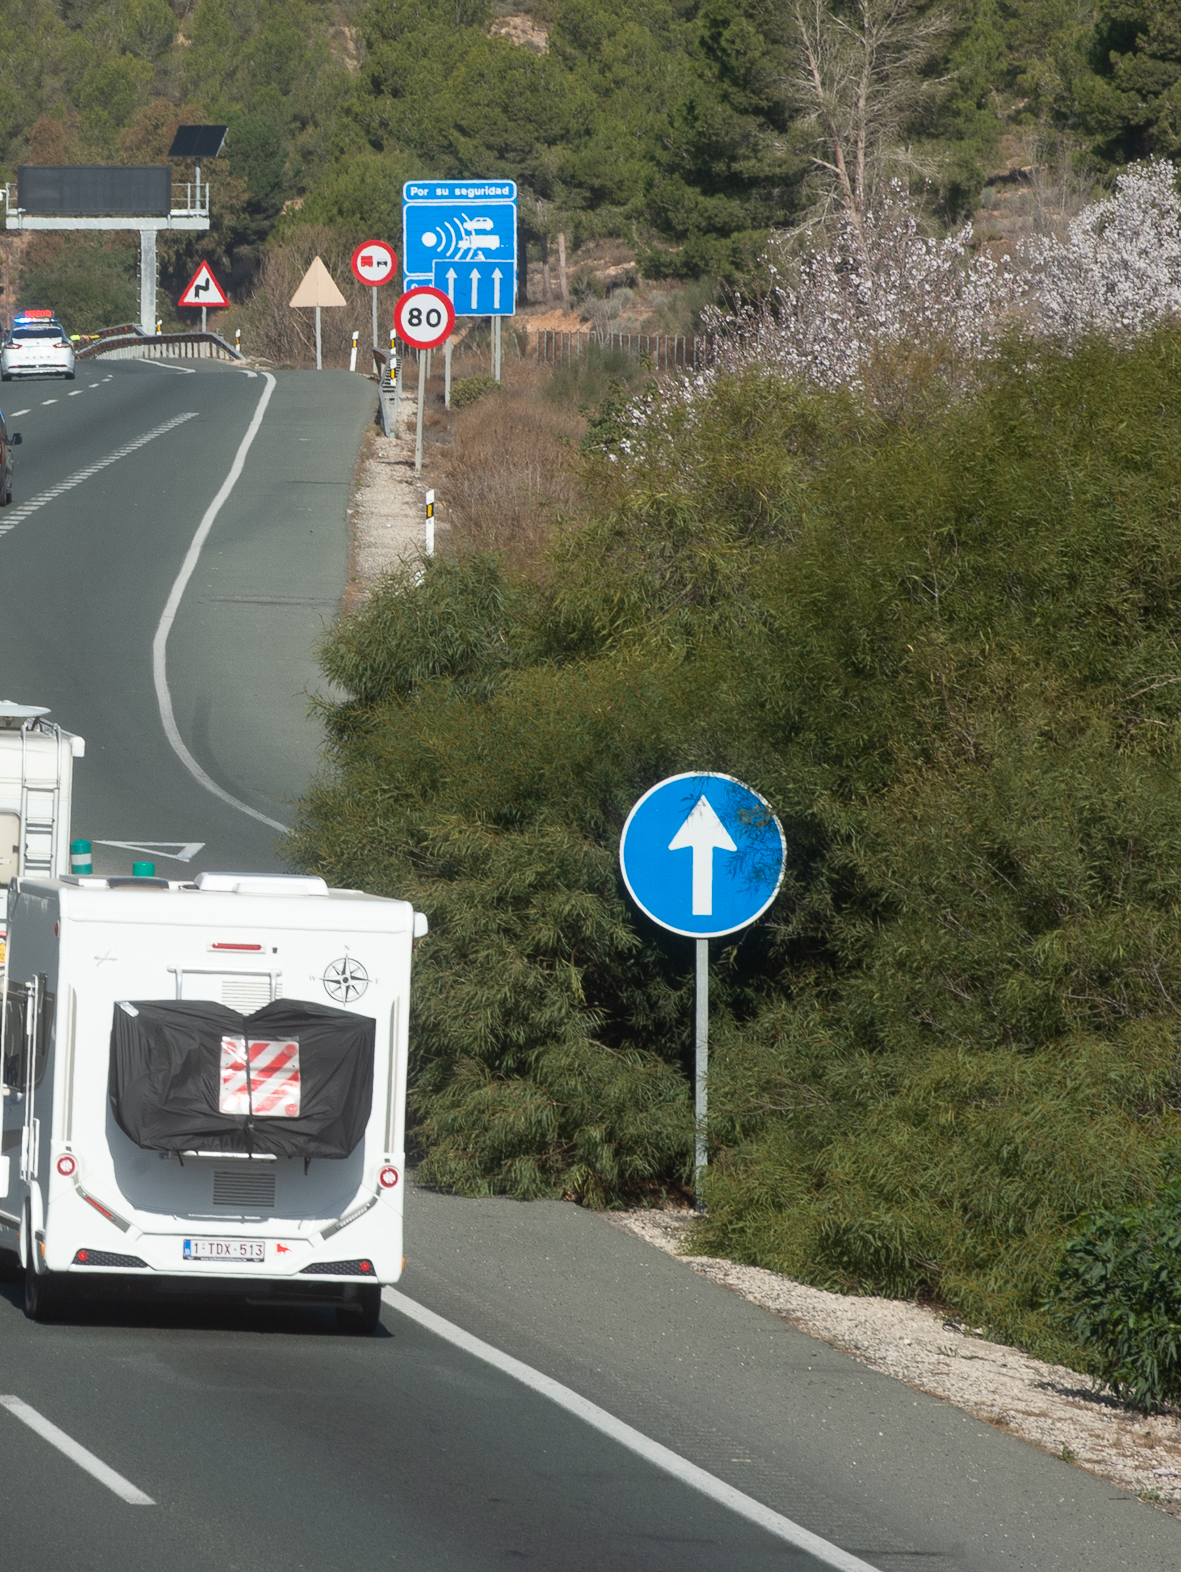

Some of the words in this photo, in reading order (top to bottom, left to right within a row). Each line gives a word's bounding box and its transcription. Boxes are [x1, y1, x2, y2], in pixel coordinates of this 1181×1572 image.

[410, 186, 429, 196] Por
[436, 187, 449, 196] su
[455, 185, 509, 198] seguridad
[407, 307, 442, 328] 80
